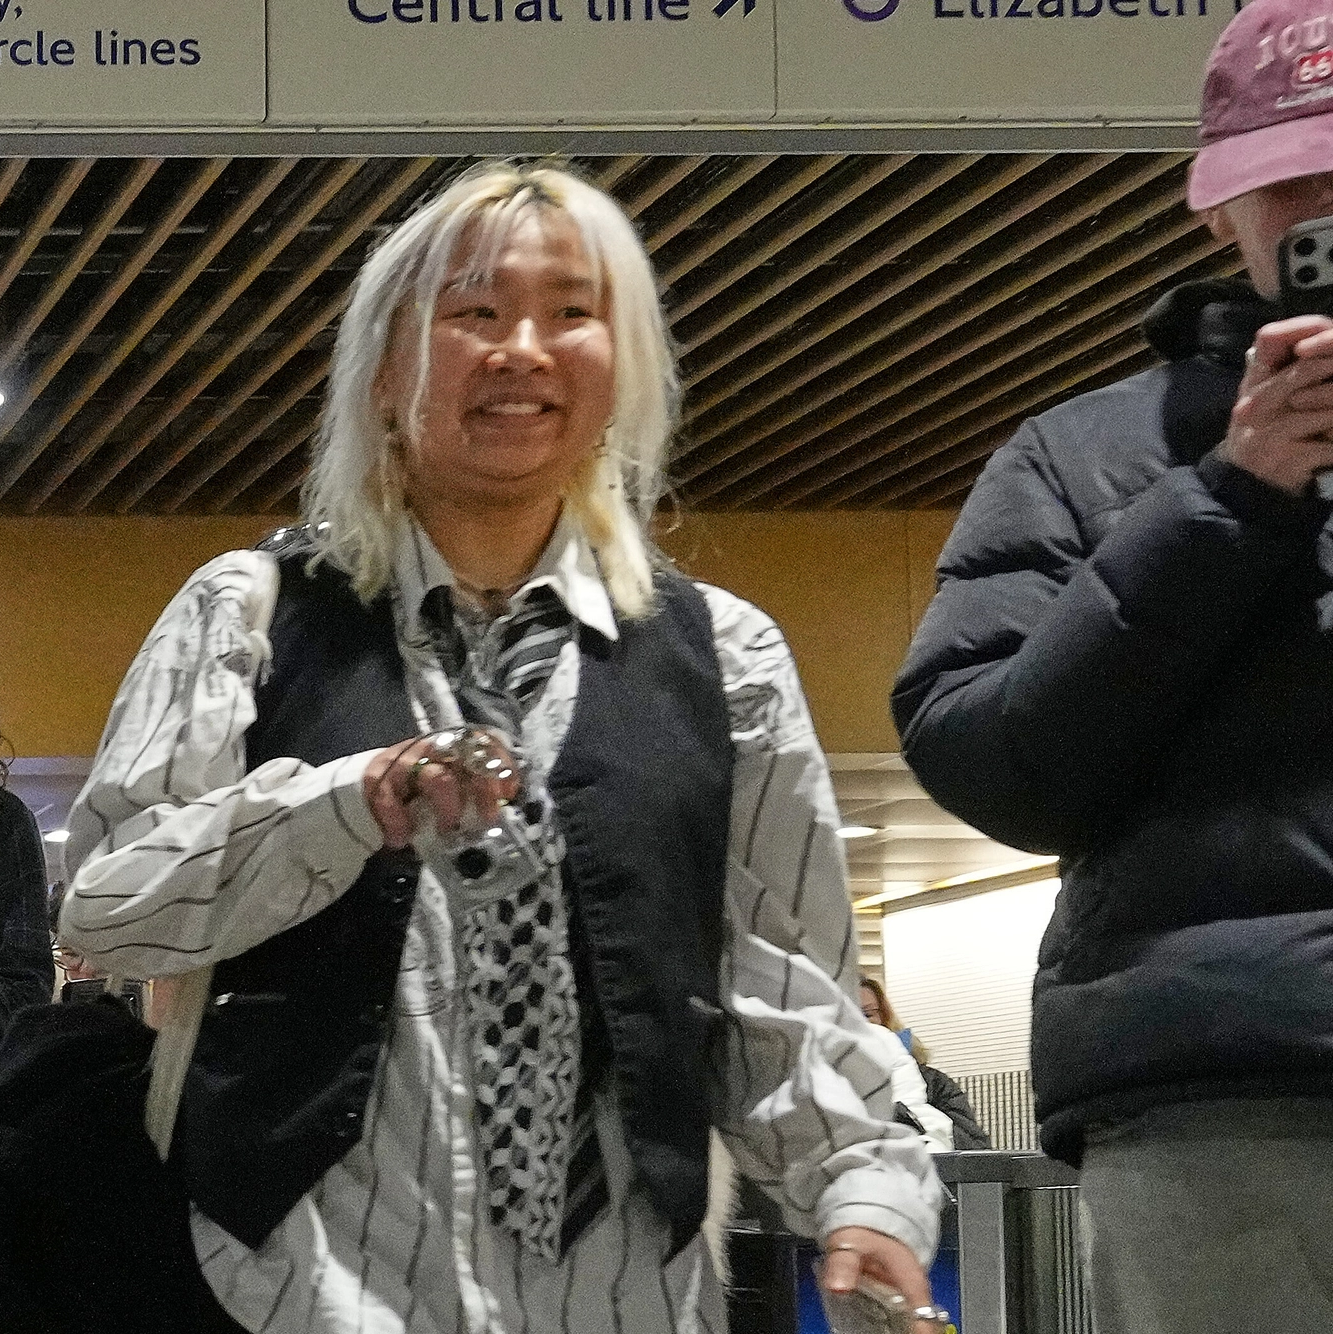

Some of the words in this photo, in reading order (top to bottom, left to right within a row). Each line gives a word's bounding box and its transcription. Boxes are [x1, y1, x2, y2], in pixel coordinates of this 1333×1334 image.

[347, 0, 563, 23] Central
[586, 0, 690, 21] line
[94, 30, 202, 66] lines
